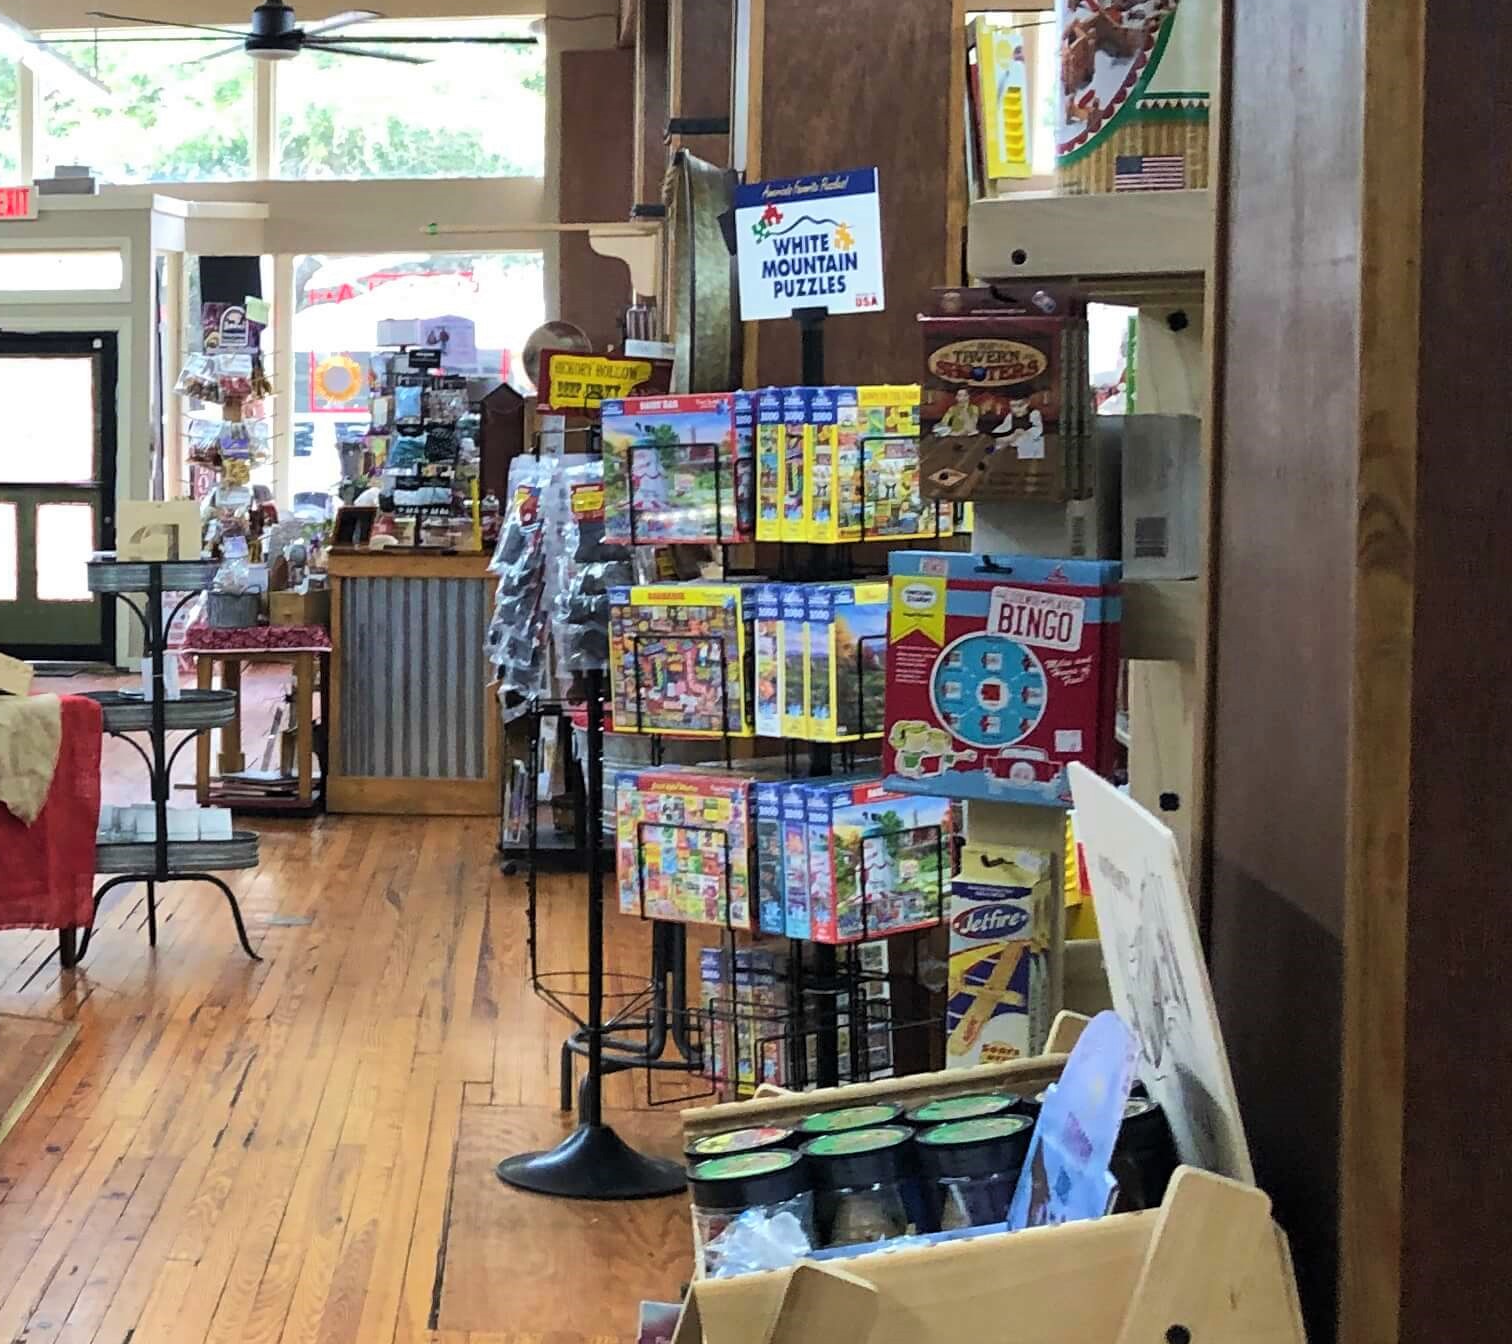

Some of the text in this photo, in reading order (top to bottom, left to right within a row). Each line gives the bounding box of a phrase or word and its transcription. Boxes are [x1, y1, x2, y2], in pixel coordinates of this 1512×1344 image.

[773, 234, 829, 256] WHITE
[761, 252, 857, 279] MOUNTAIN
[773, 275, 847, 299] PUZZLES
[855, 296, 878, 308] USA
[953, 350, 1021, 364] TAVERN
[595, 363, 638, 380] HOLLOW
[997, 603, 1074, 643] BINGO
[959, 909, 1021, 934] Jetfire
